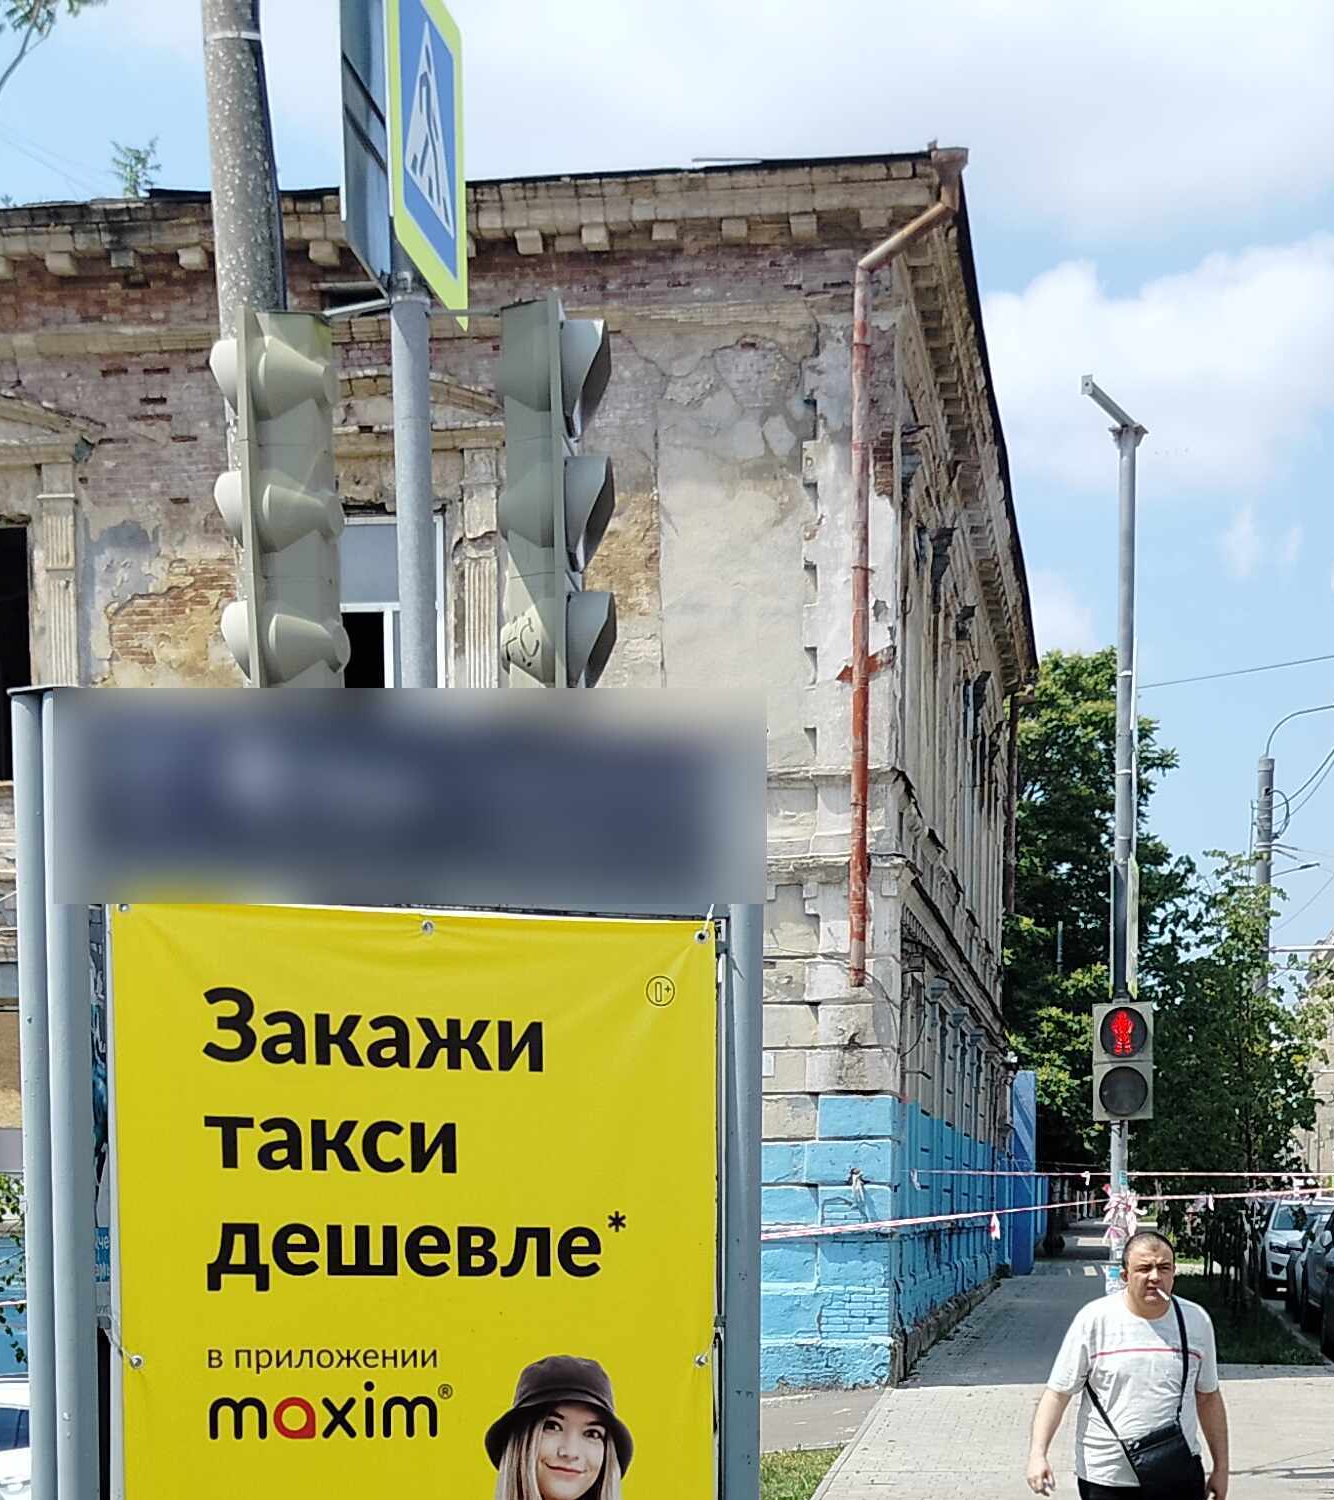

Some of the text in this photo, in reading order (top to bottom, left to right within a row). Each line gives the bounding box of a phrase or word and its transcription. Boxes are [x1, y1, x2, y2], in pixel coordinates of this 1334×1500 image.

[202, 986, 544, 1073] Закажи
[203, 1115, 457, 1174] такси
[207, 1348, 438, 1375] в приложении
